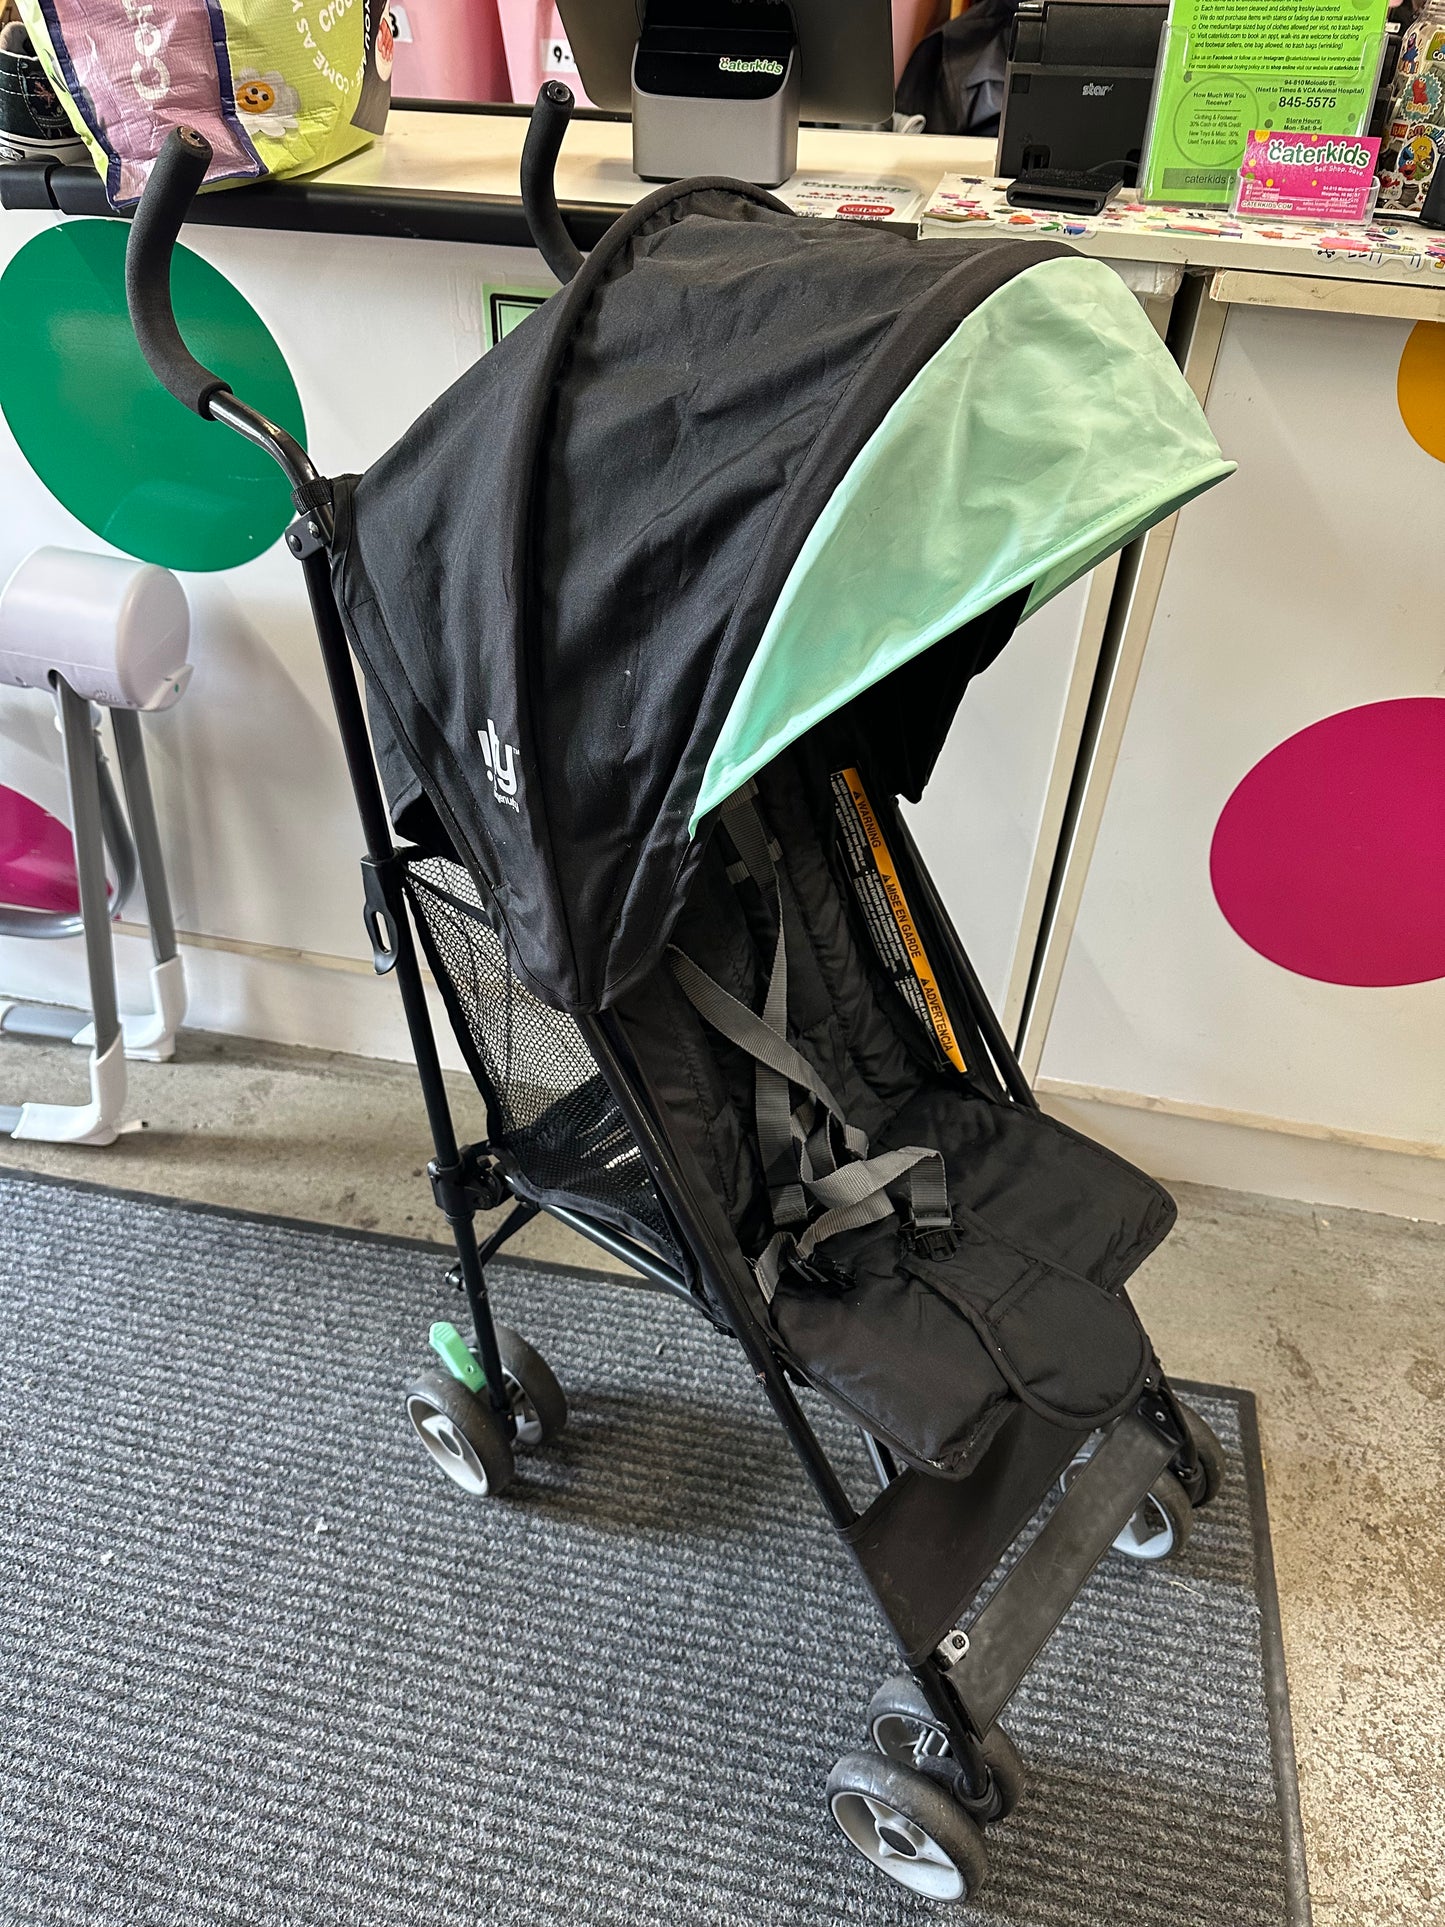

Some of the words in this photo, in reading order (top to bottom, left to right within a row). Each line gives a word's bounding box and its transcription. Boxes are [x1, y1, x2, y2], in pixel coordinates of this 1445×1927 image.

[296, 18, 317, 48] AS
[313, 50, 349, 94] COME
[720, 58, 782, 74] caterkids
[1082, 83, 1109, 96] star
[1279, 96, 1336, 108] 845-5575
[1268, 140, 1370, 167] caterkids
[1348, 168, 1364, 176] Save.
[1242, 201, 1292, 209] CATERKIDS.COM
[857, 800, 882, 849] WARNING
[886, 882, 902, 908] MISE
[895, 908, 908, 923] EN
[901, 923, 921, 959] GARDE
[922, 986, 955, 1052] ADVERTENCIA
